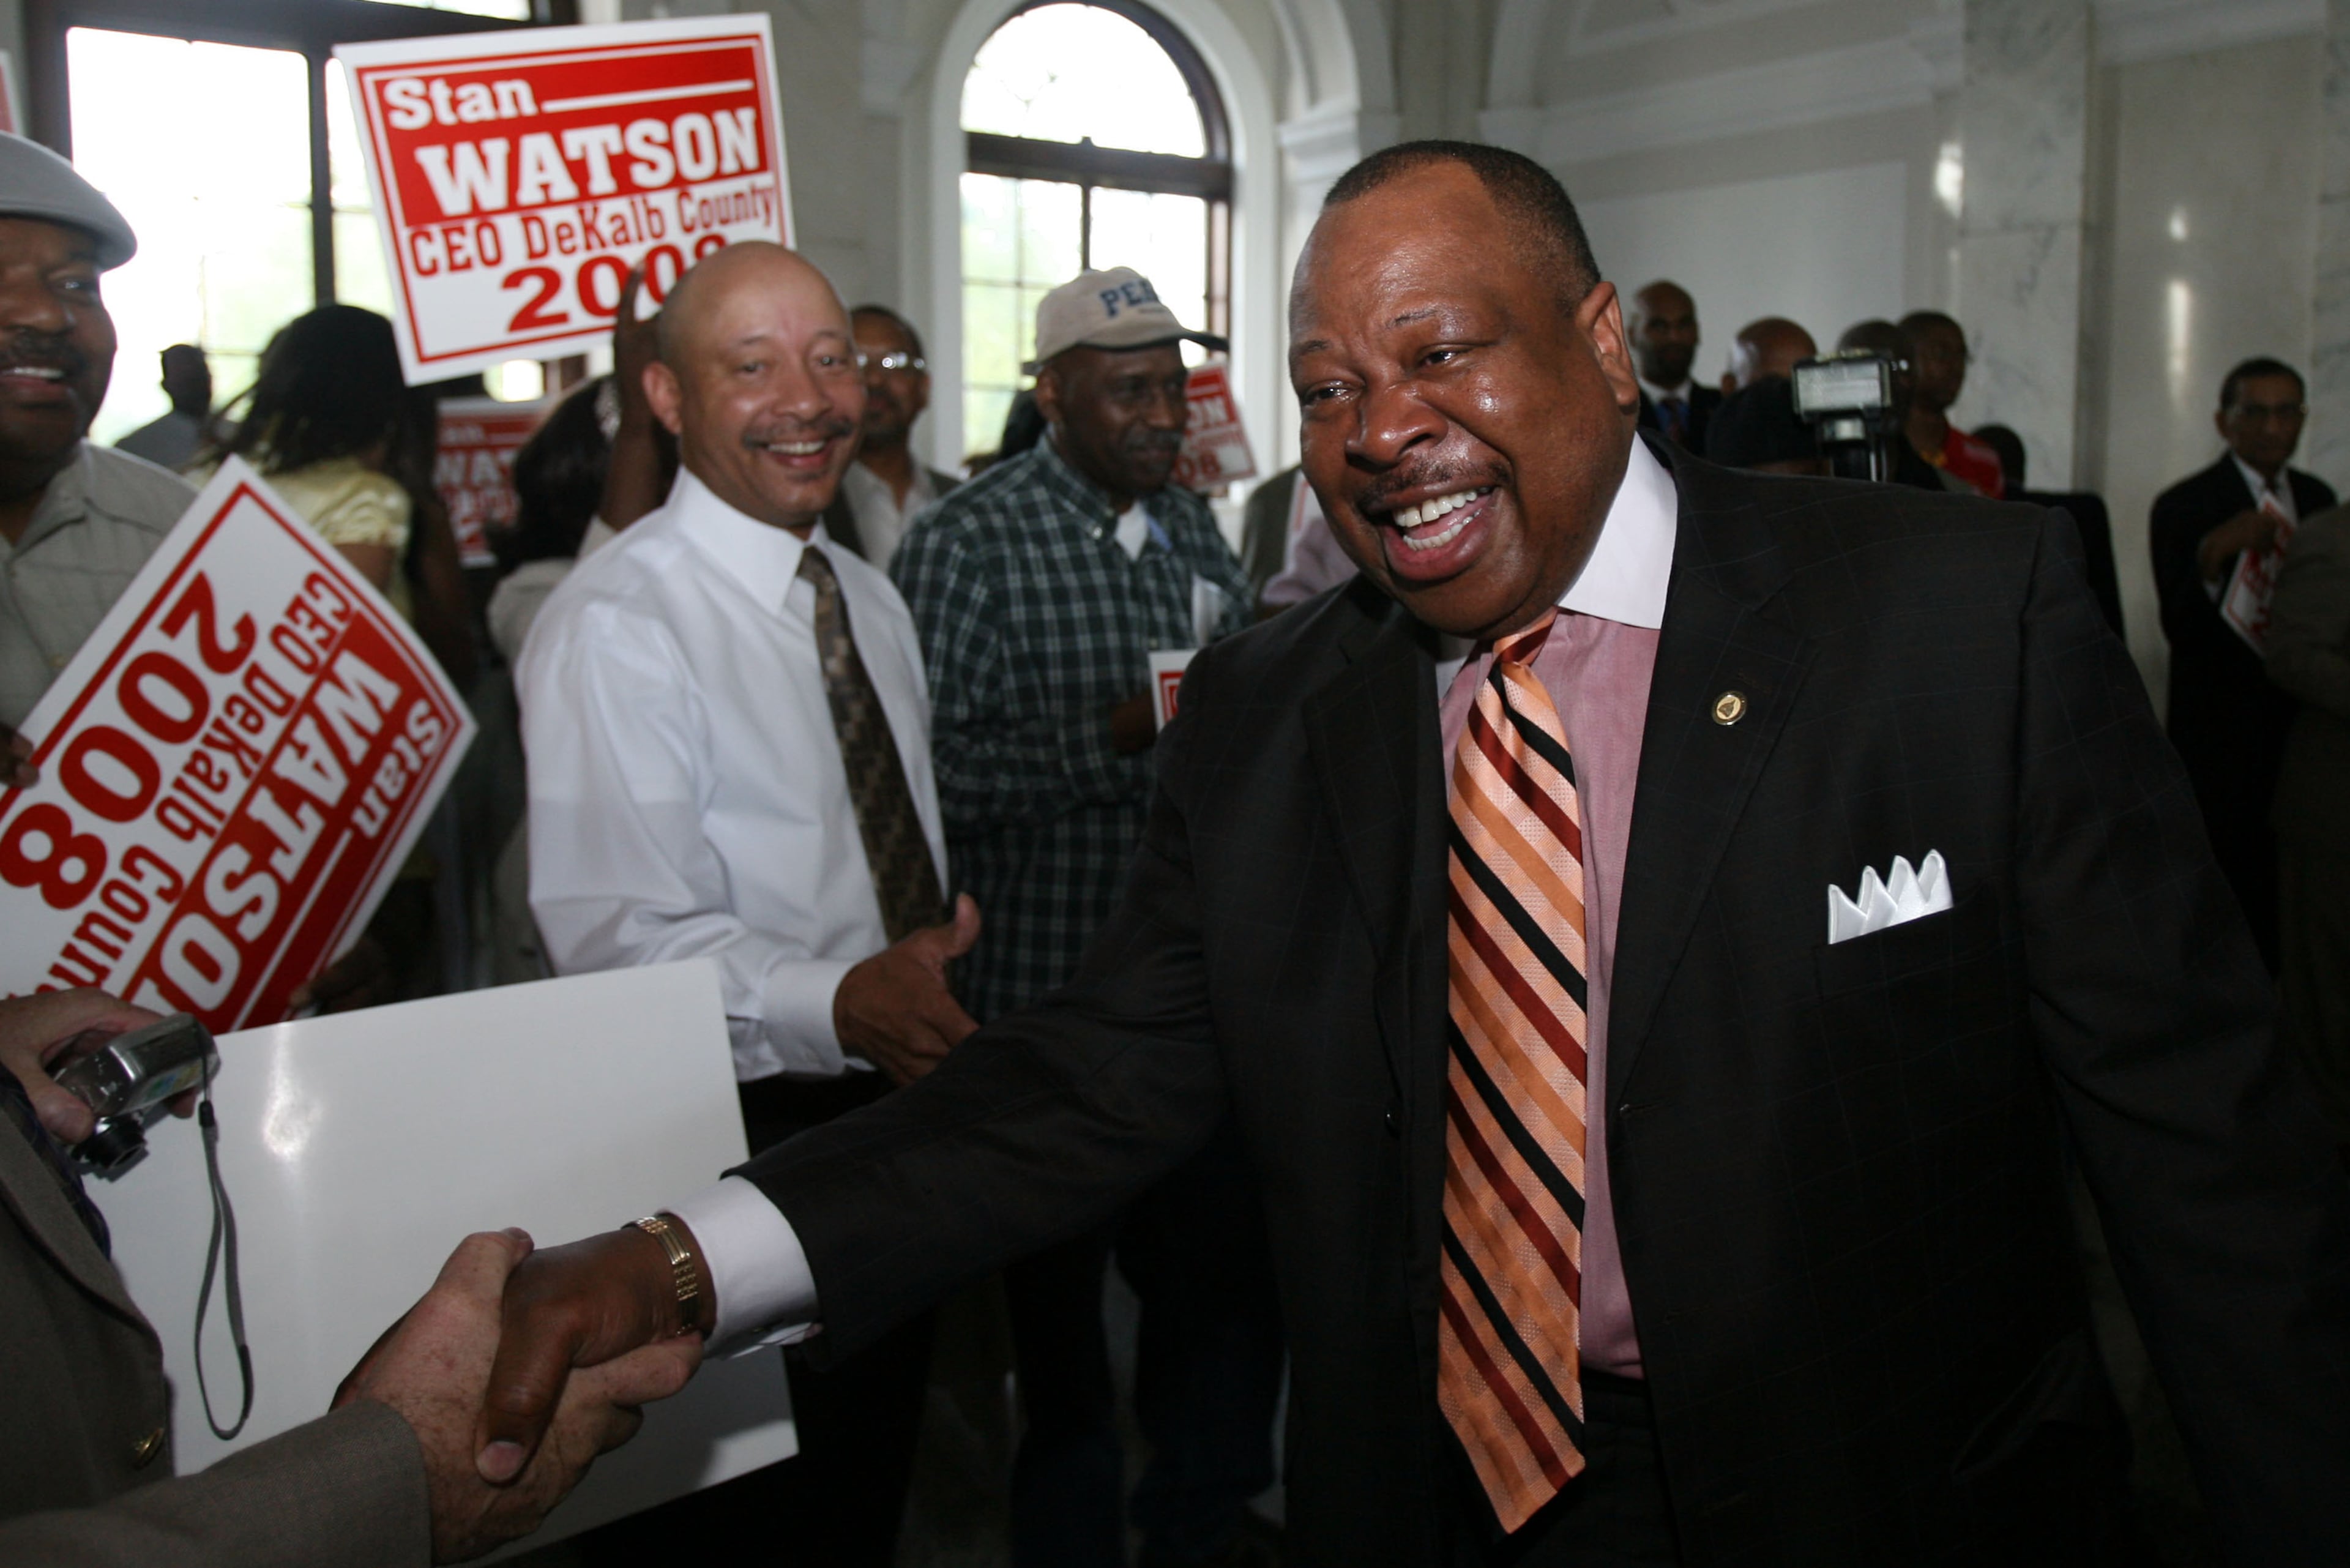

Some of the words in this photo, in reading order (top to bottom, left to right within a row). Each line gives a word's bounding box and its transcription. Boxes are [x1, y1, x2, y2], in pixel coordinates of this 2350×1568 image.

[384, 77, 538, 129] Stan
[414, 107, 760, 217] WATSON
[410, 222, 502, 275] CEO
[521, 198, 665, 259] DeKalb
[677, 185, 775, 233] County
[269, 571, 356, 676] CEO
[0, 571, 257, 910] 2008
[154, 662, 297, 842] DeKalb
[351, 698, 443, 838] Stan
[7, 844, 185, 999] Coun
